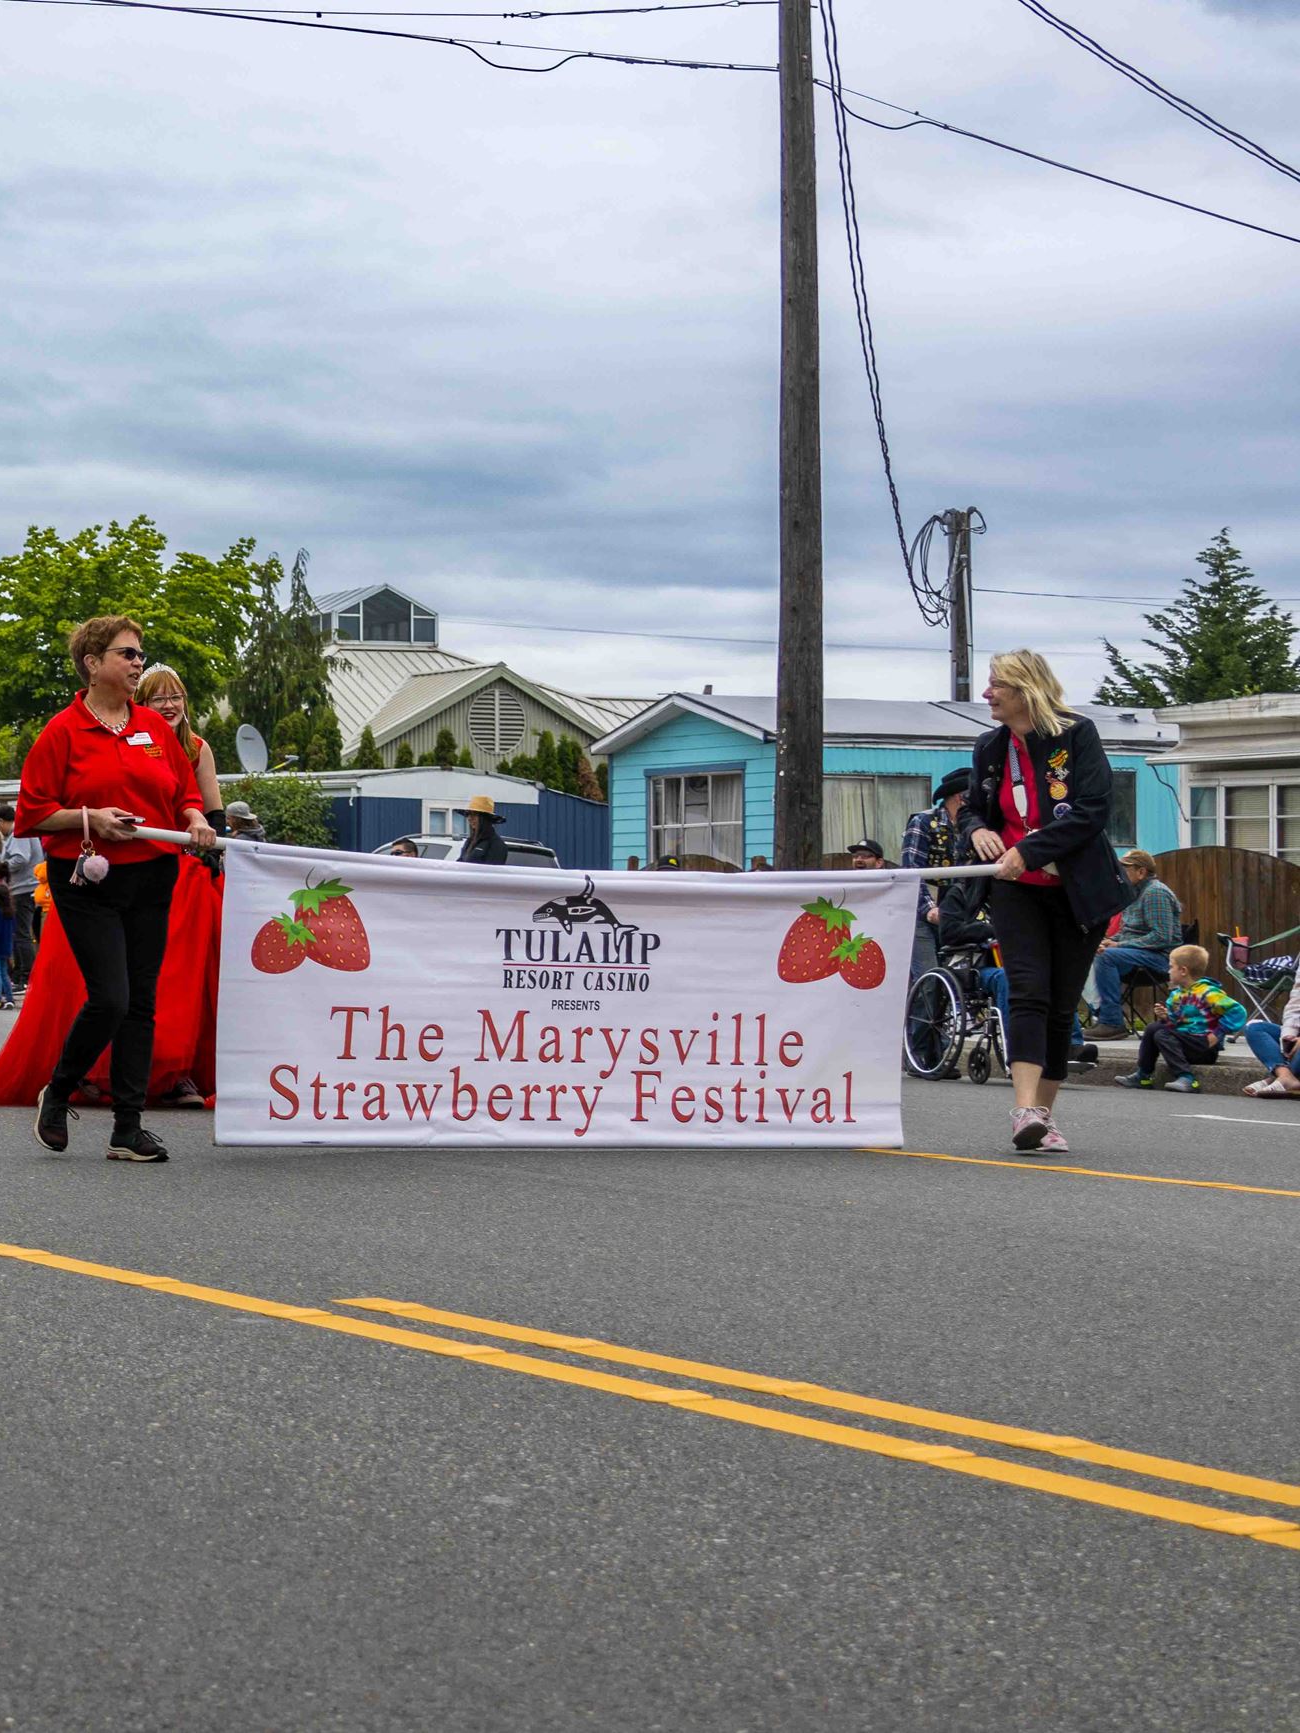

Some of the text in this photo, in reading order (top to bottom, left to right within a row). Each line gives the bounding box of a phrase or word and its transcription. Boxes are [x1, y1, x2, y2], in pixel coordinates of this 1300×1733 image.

[496, 927, 661, 966] TULALIP
[503, 969, 650, 993] RESORT CASINO
[551, 999, 601, 1012] PRESENTS
[330, 1005, 804, 1079] The Marysville
[268, 1063, 857, 1137] Strawberry Festival
